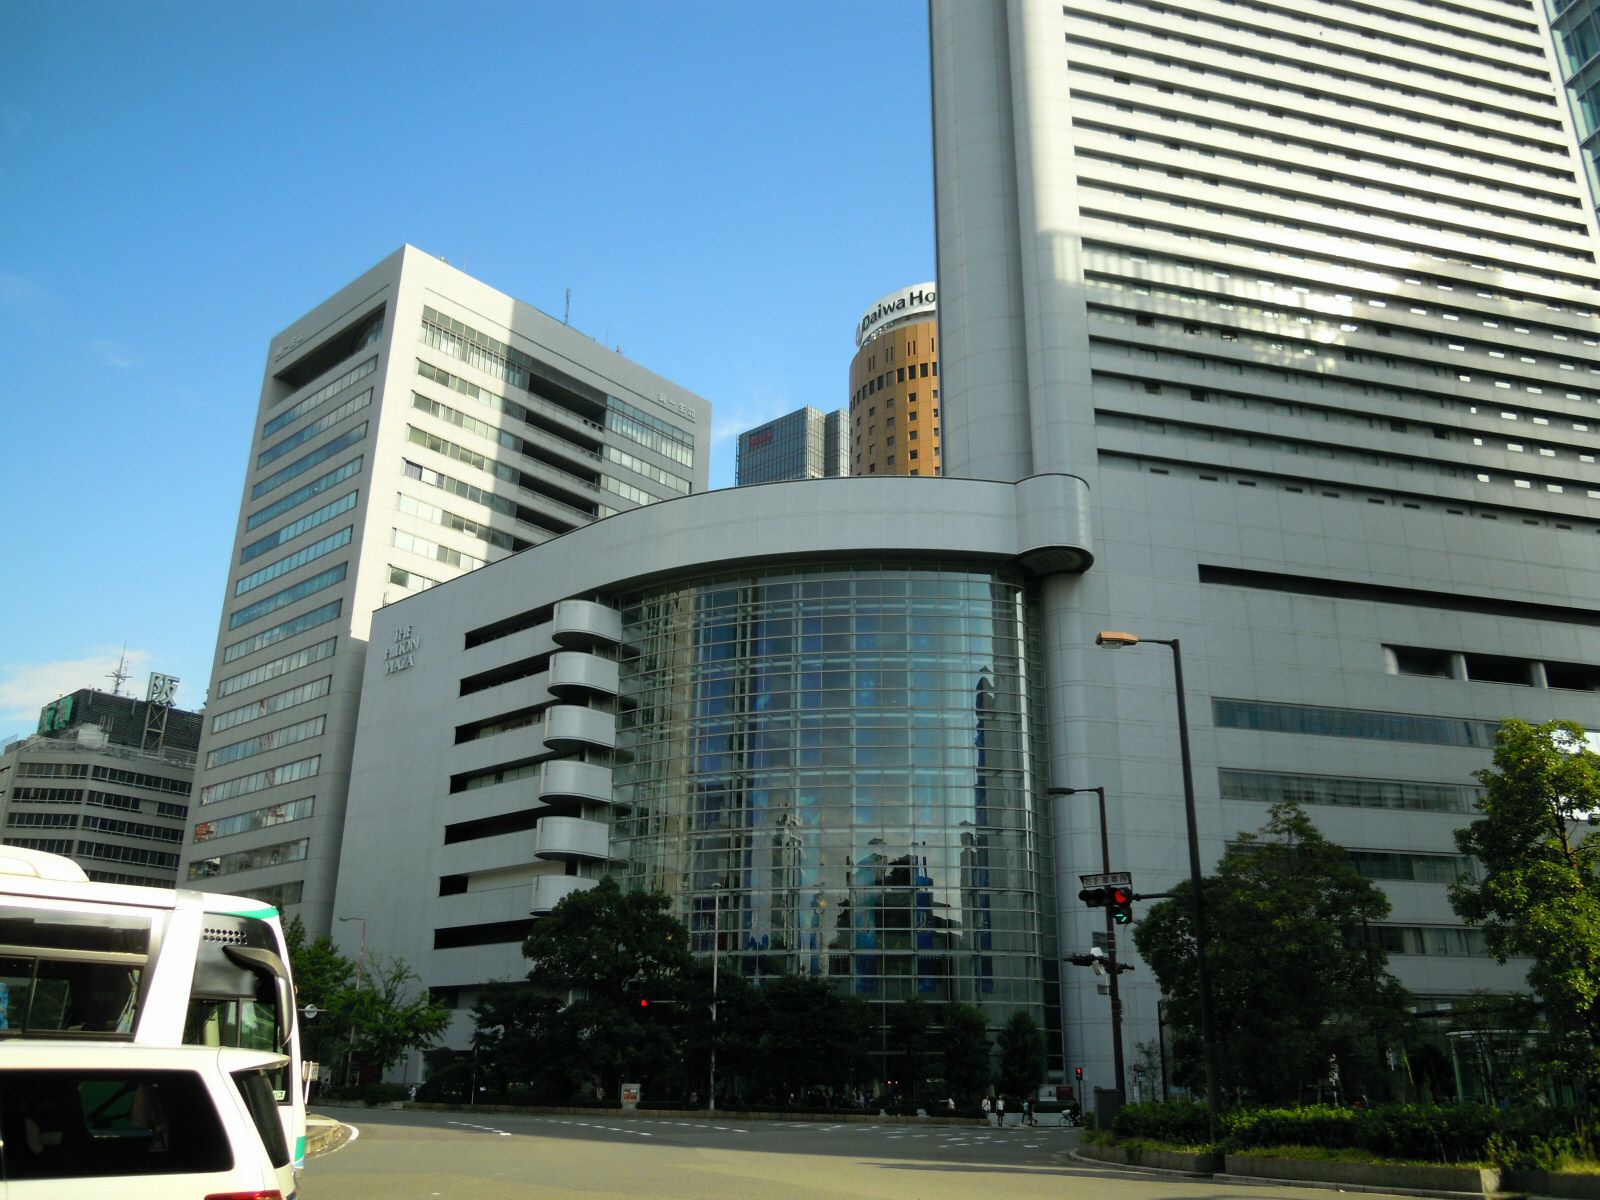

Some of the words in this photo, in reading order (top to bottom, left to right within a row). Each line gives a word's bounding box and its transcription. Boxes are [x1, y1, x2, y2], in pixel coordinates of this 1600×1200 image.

[862, 298, 906, 332] Daiwa
[394, 625, 413, 643] THE
[385, 654, 414, 675] PLAZA
